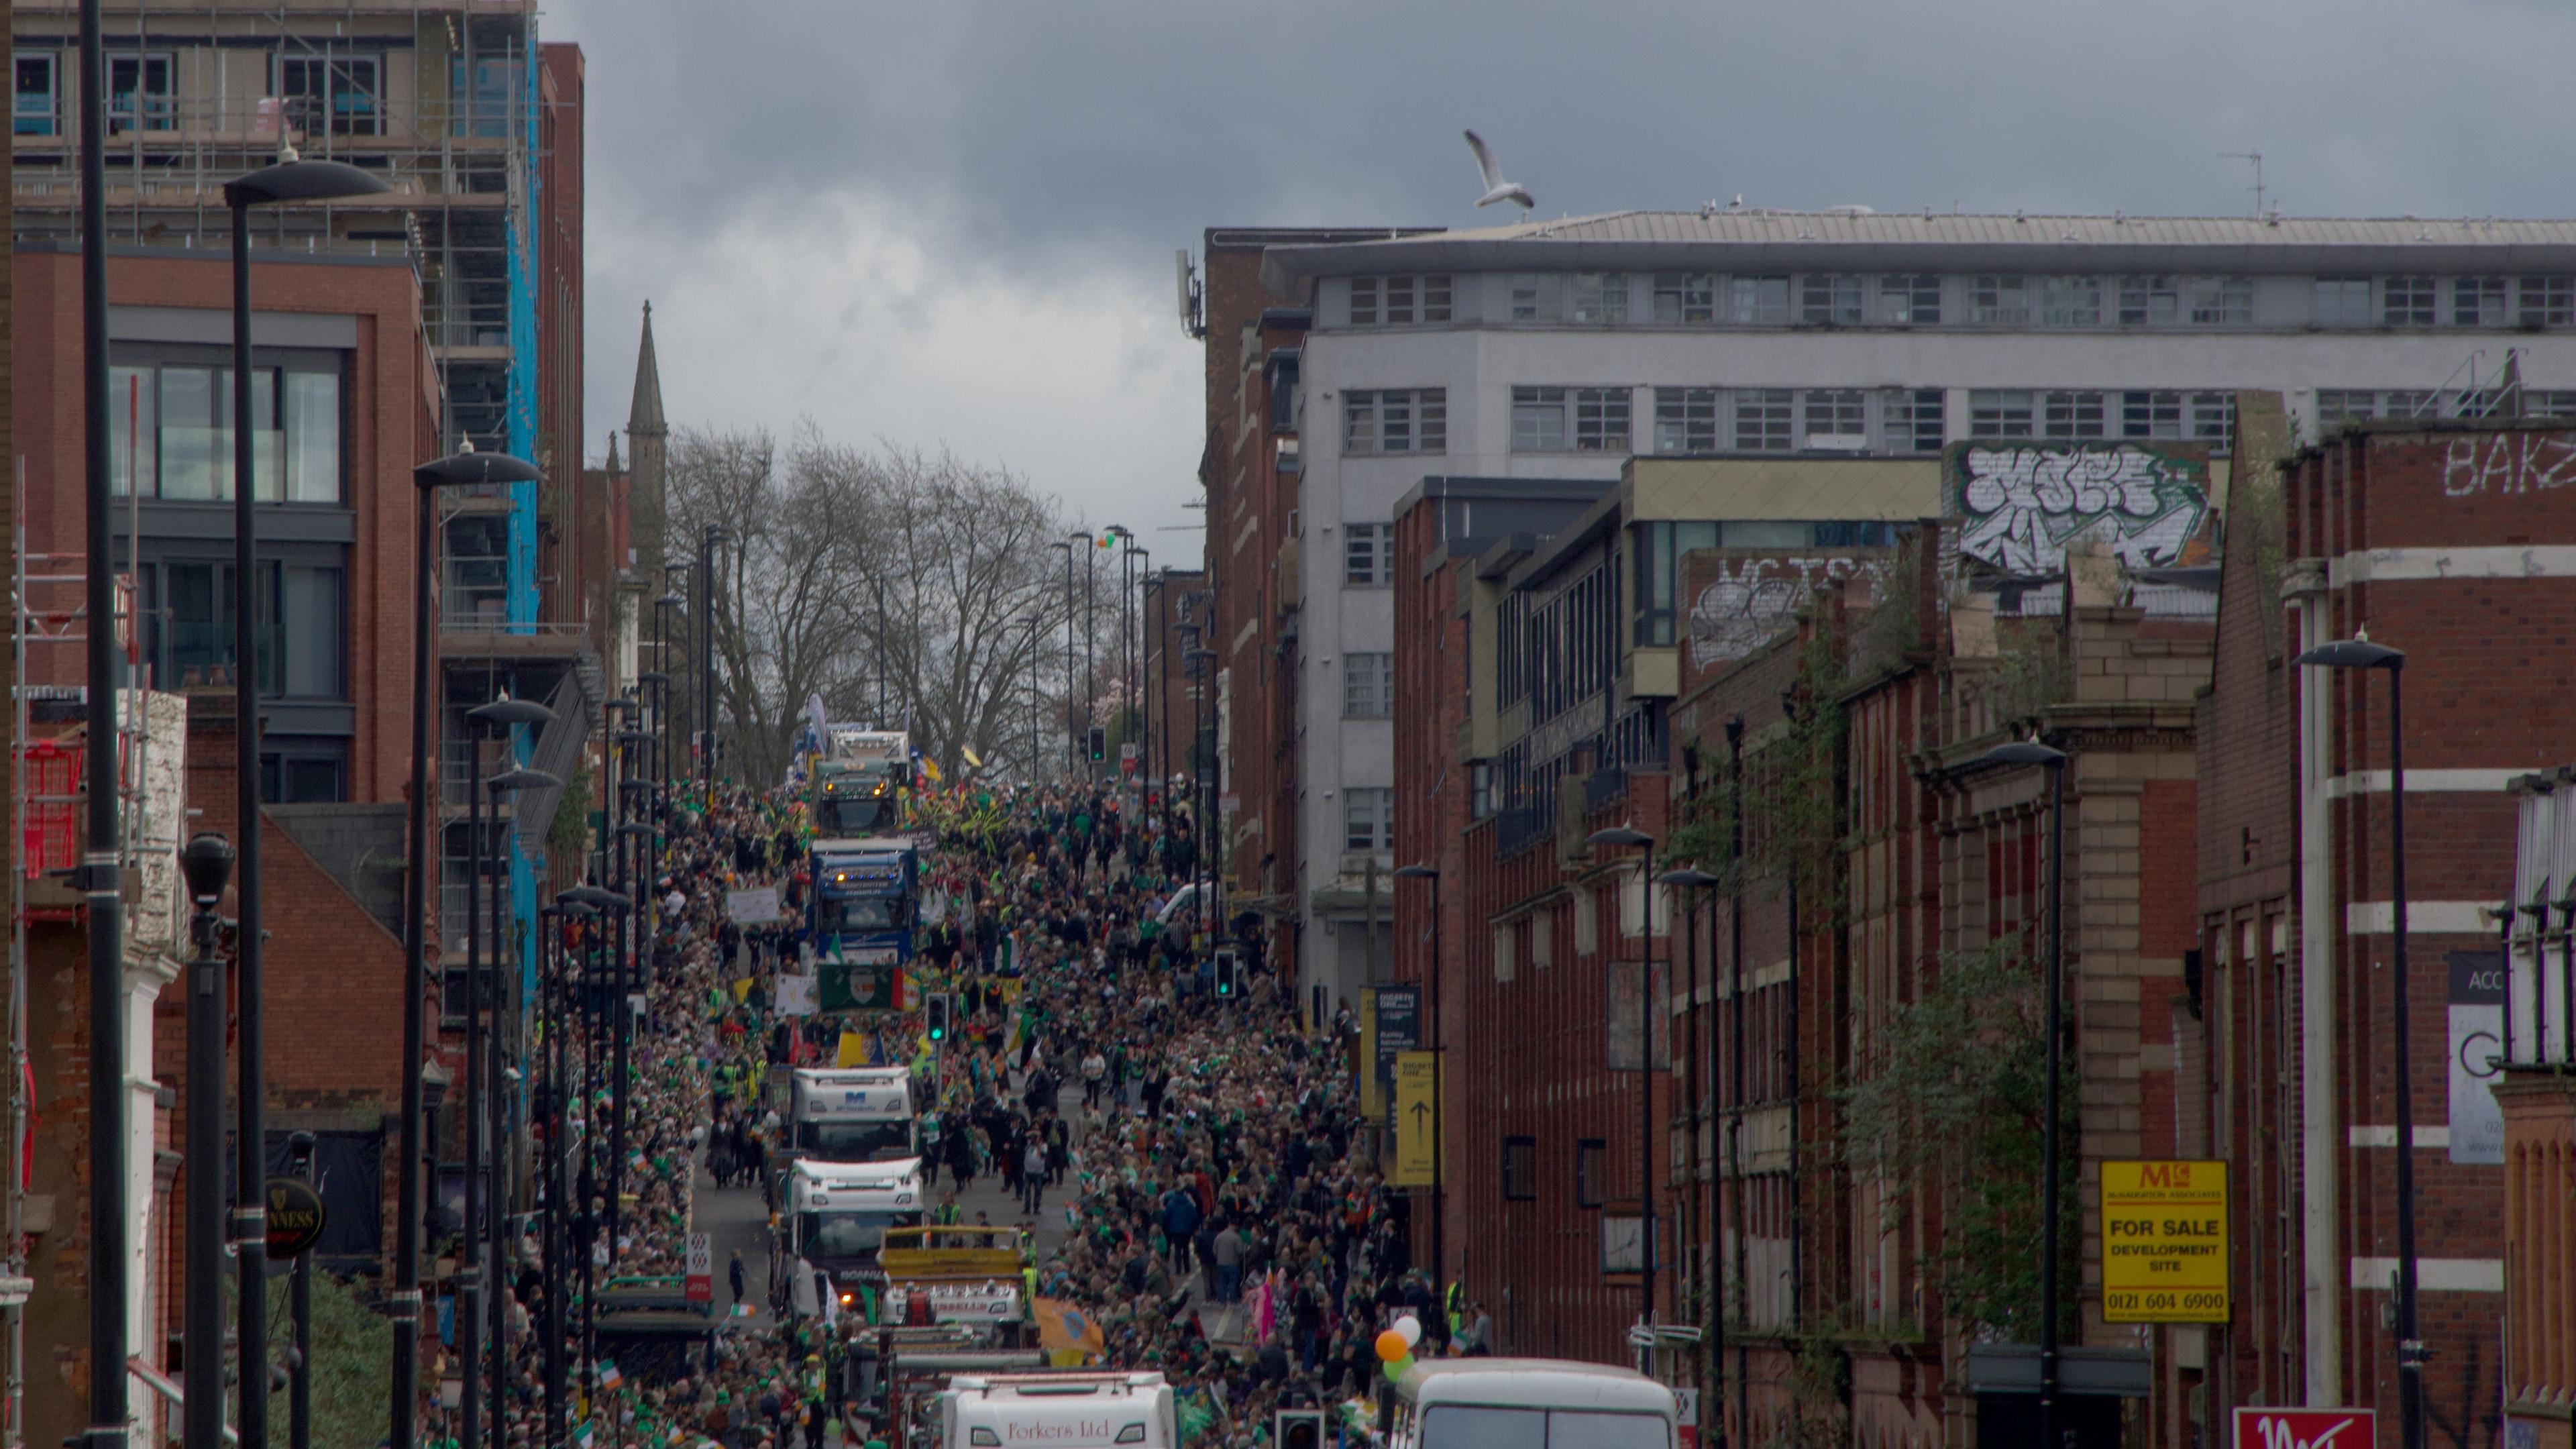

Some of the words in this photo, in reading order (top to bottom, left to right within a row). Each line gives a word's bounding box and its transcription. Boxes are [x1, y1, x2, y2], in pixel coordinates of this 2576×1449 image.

[1380, 993, 1414, 1001] DIGBETH
[267, 1210, 314, 1229] NNESS
[2110, 1220, 2153, 1236] FOR
[2163, 1220, 2219, 1236] SALE
[2111, 1245, 2218, 1256] DEVELOPMENT
[2149, 1260, 2182, 1272] SITE
[2108, 1294, 2139, 1309] 0121
[2146, 1294, 2176, 1309] 604
[2184, 1294, 2224, 1309] 6900
[1008, 1421, 1073, 1440] Forkers
[1081, 1418, 1110, 1438] Ltd
